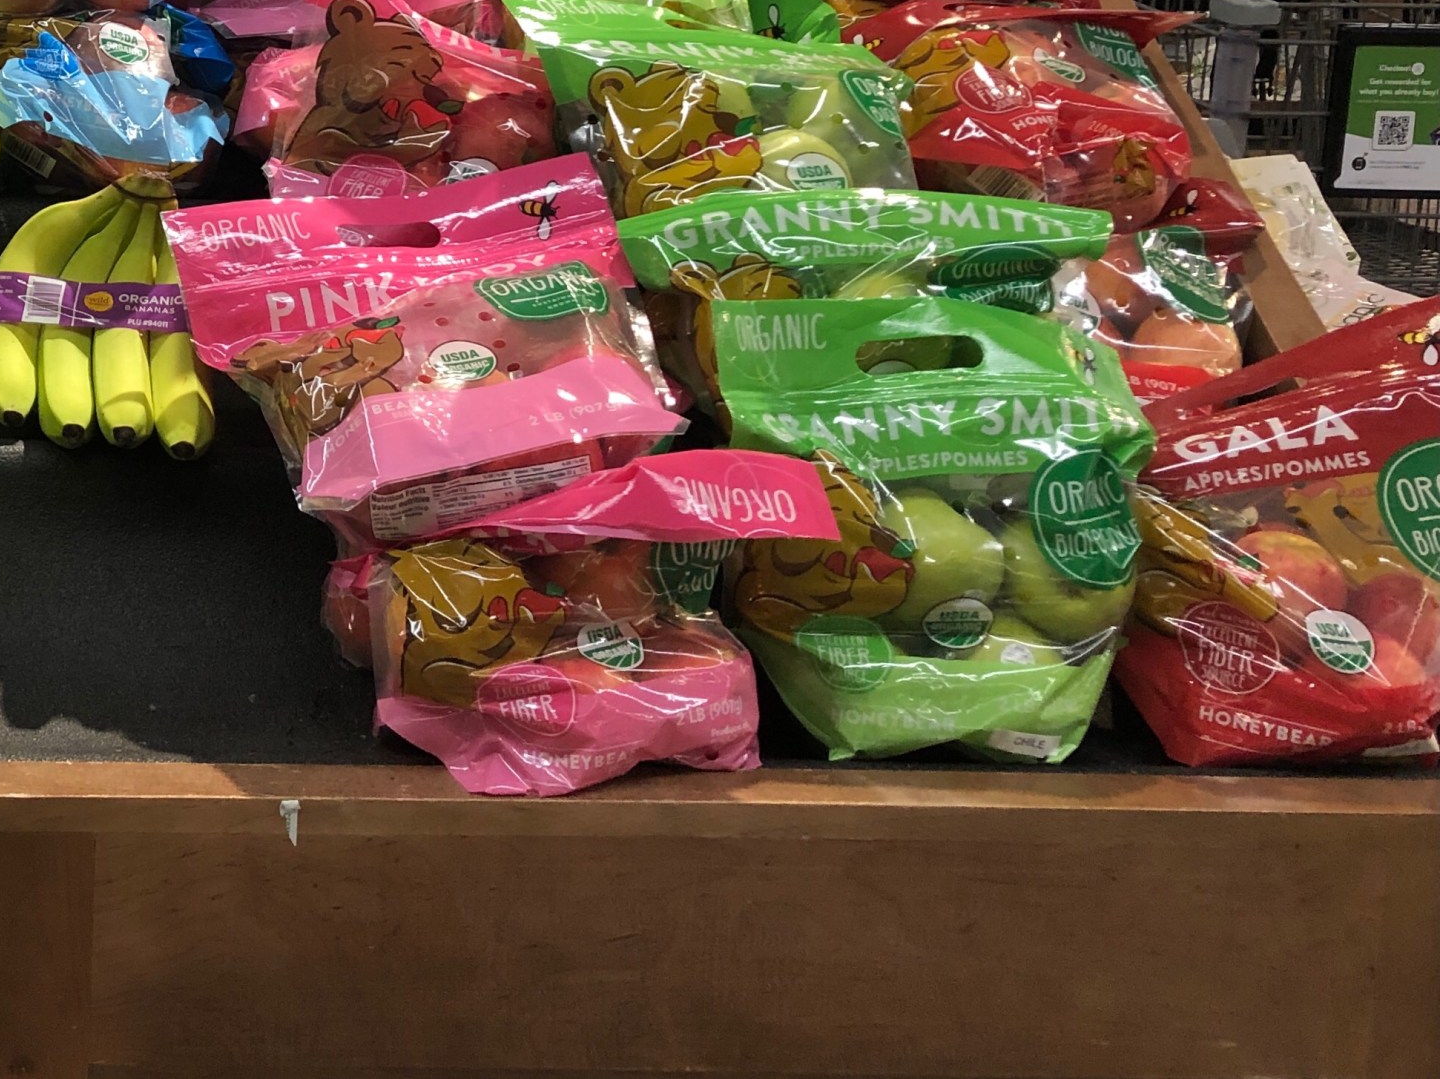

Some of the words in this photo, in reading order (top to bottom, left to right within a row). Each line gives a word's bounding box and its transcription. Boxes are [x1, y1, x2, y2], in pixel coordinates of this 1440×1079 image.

[110, 28, 138, 44] USDA
[798, 165, 832, 177] USDA
[201, 212, 311, 252] ORGANIC
[664, 198, 886, 250] GRANNY
[90, 296, 110, 304] wild
[118, 294, 184, 306] ORGANIC
[124, 305, 176, 314] BANANAS
[264, 273, 393, 332] PINK
[128, 318, 142, 326] PLU
[142, 319, 169, 328] #94011
[736, 313, 827, 352] ORGANIC
[440, 349, 480, 363] USDA
[763, 398, 958, 446] GRANNY
[980, 396, 1139, 436] SMITH
[1174, 404, 1359, 464] GALA
[1184, 450, 1371, 492] APPLES/POMMES
[371, 492, 405, 503] Nutrition
[674, 476, 797, 524] ORGANIC
[939, 610, 980, 620] USDA
[587, 627, 621, 643] USDA
[816, 646, 870, 666] FIBER
[1197, 638, 1259, 678] FIBER
[1200, 665, 1246, 690] SOURCE
[498, 694, 558, 722] FIBER
[676, 712, 685, 726] 2
[688, 710, 706, 722] LB
[1200, 706, 1334, 747] HONEYBEAR
[1013, 734, 1046, 750] CHILE
